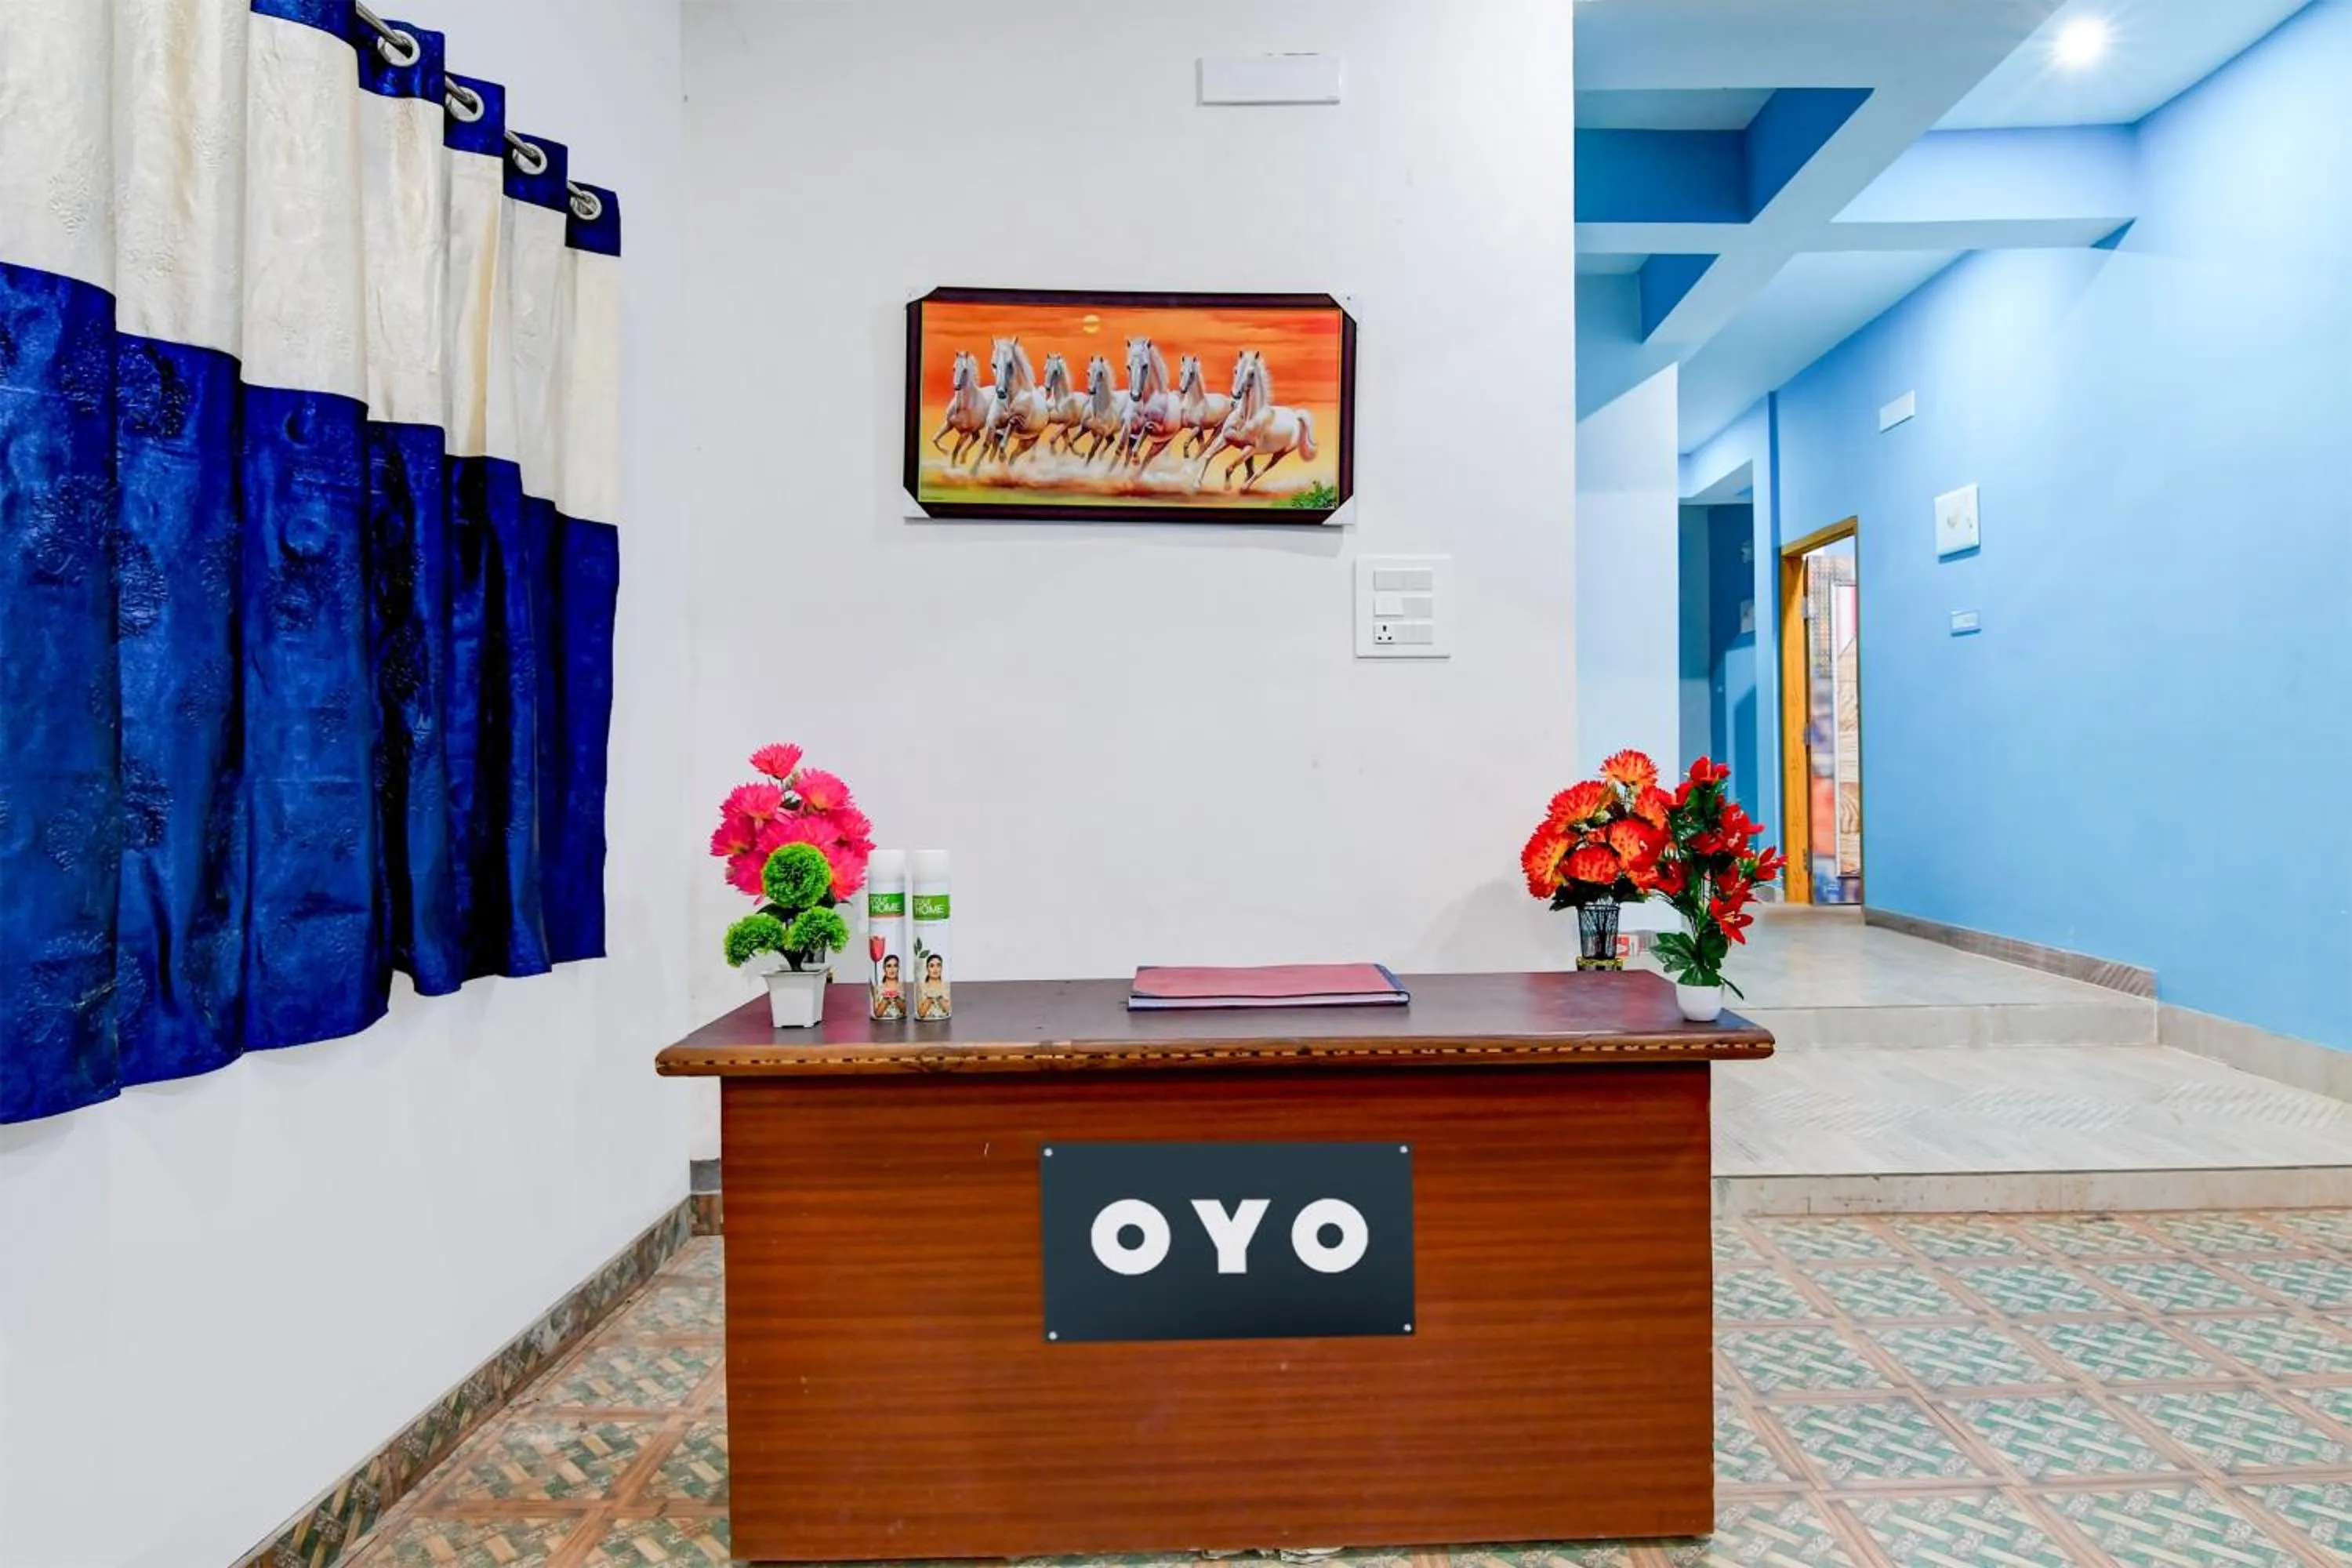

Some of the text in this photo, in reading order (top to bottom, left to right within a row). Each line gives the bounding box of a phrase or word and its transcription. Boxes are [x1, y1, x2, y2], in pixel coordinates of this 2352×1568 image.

[871, 902, 901, 913] HOME
[915, 904, 945, 915] HOME
[1091, 1198, 1369, 1276] OYO
